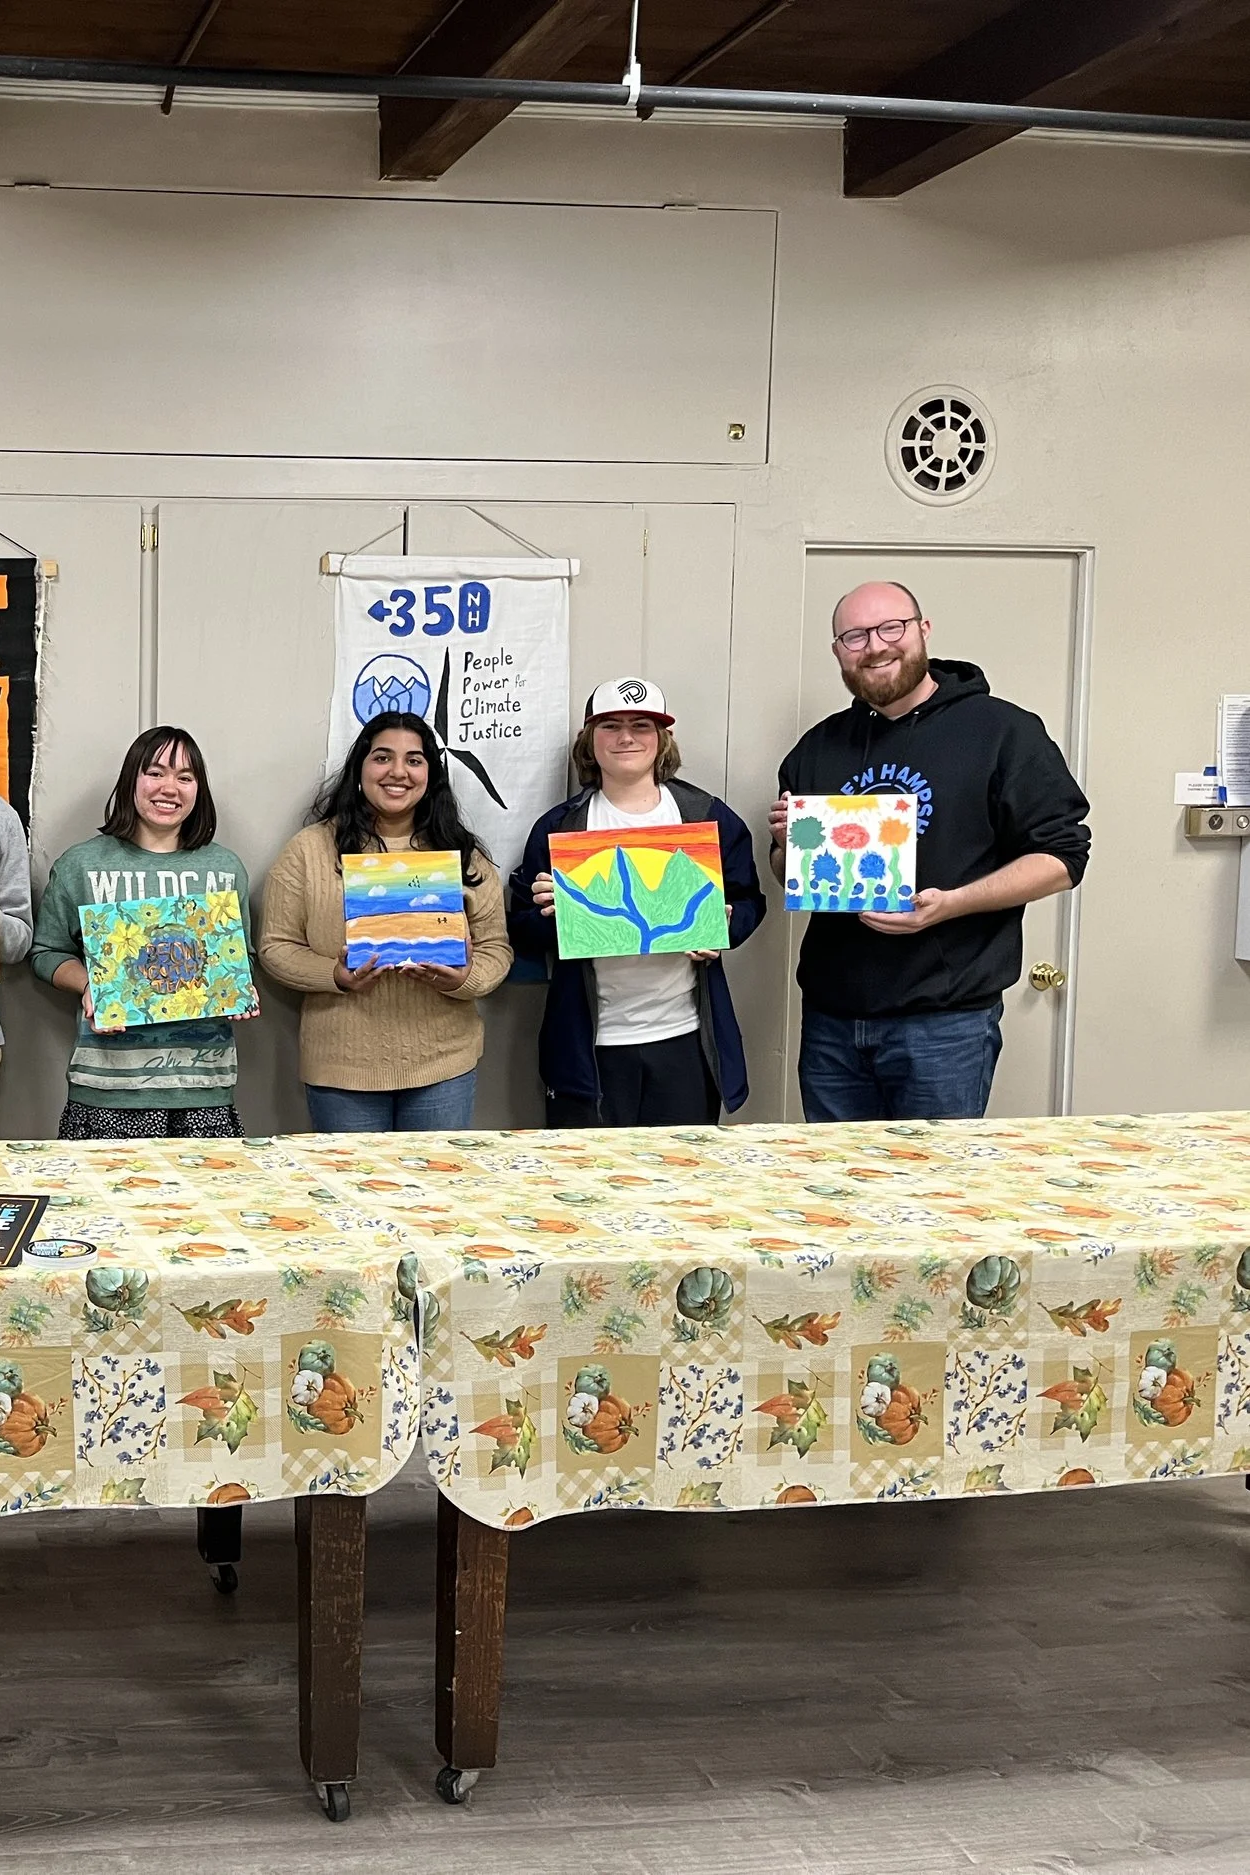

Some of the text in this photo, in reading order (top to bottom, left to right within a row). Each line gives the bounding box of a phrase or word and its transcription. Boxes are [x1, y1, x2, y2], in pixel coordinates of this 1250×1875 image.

[389, 582, 491, 637] 350
[464, 647, 513, 673] People
[463, 674, 527, 695] Power for
[461, 693, 521, 718] Climate
[459, 719, 522, 742] Justice
